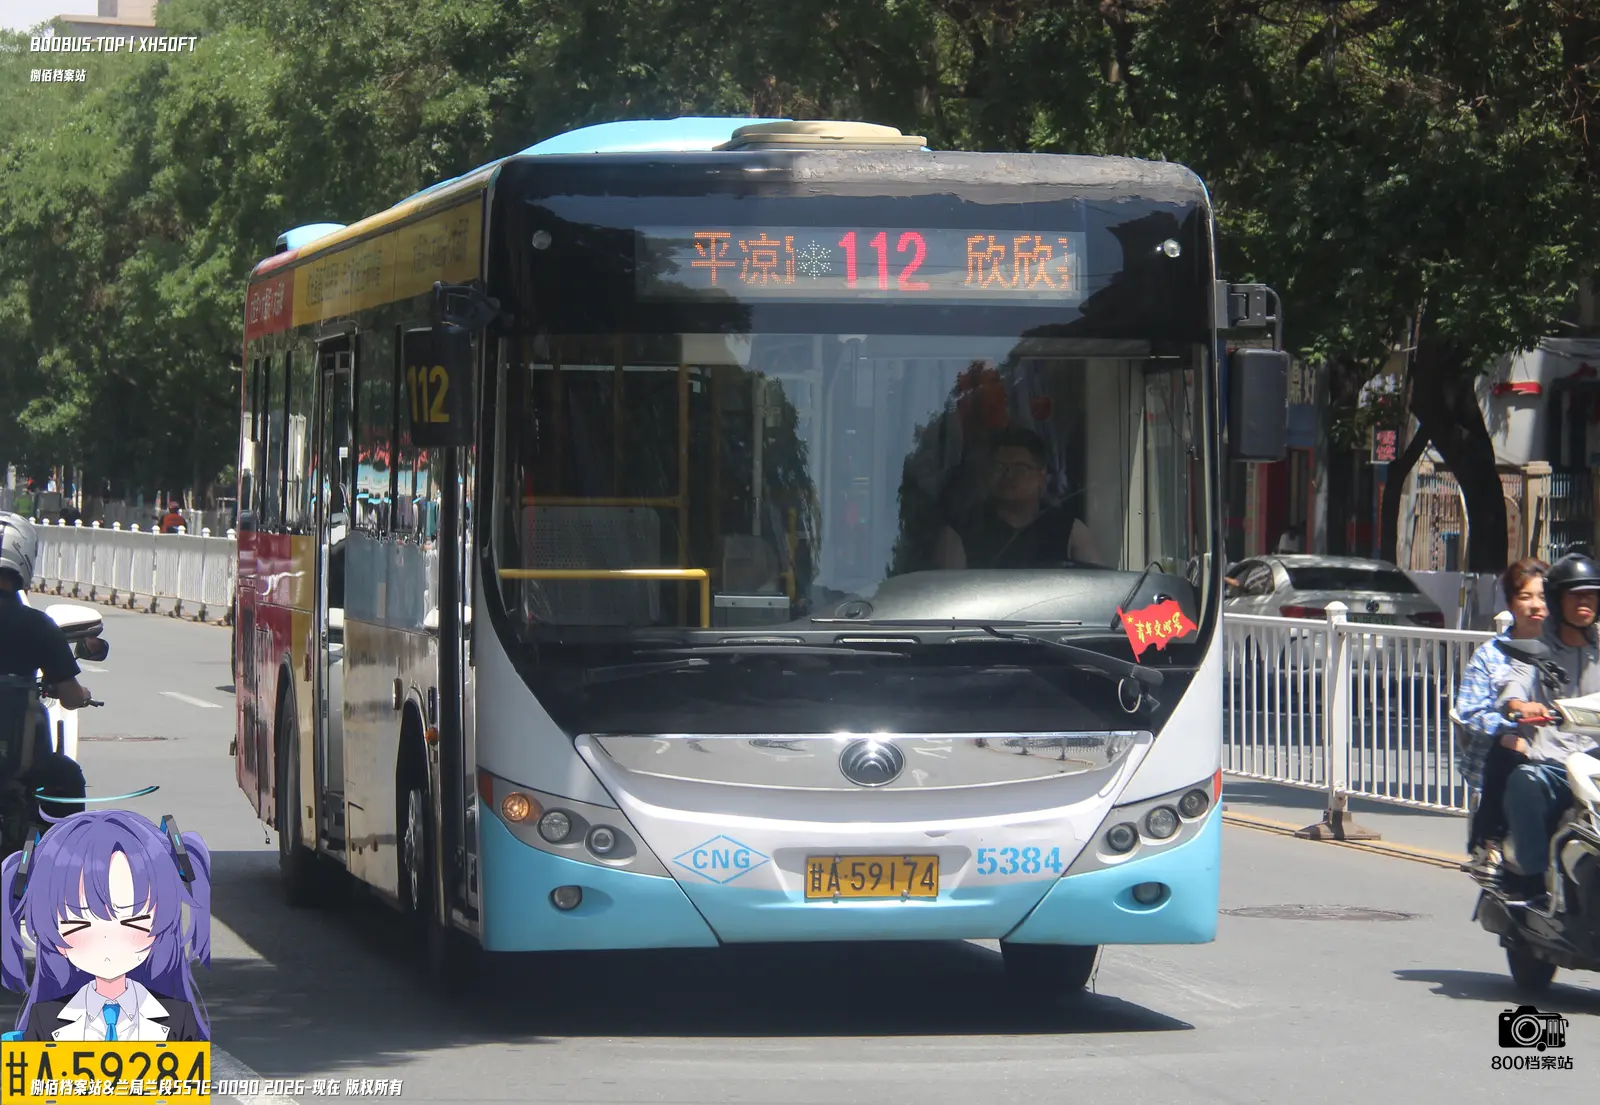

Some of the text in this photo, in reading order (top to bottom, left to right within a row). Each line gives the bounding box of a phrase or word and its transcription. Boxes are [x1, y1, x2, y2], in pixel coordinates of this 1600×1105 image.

[691, 231, 1069, 291] 平凉 112 欣欣
[406, 364, 450, 423] 112
[1134, 611, 1183, 644] 青年文明号
[692, 848, 751, 870] CNG
[976, 846, 1063, 876] 5384
